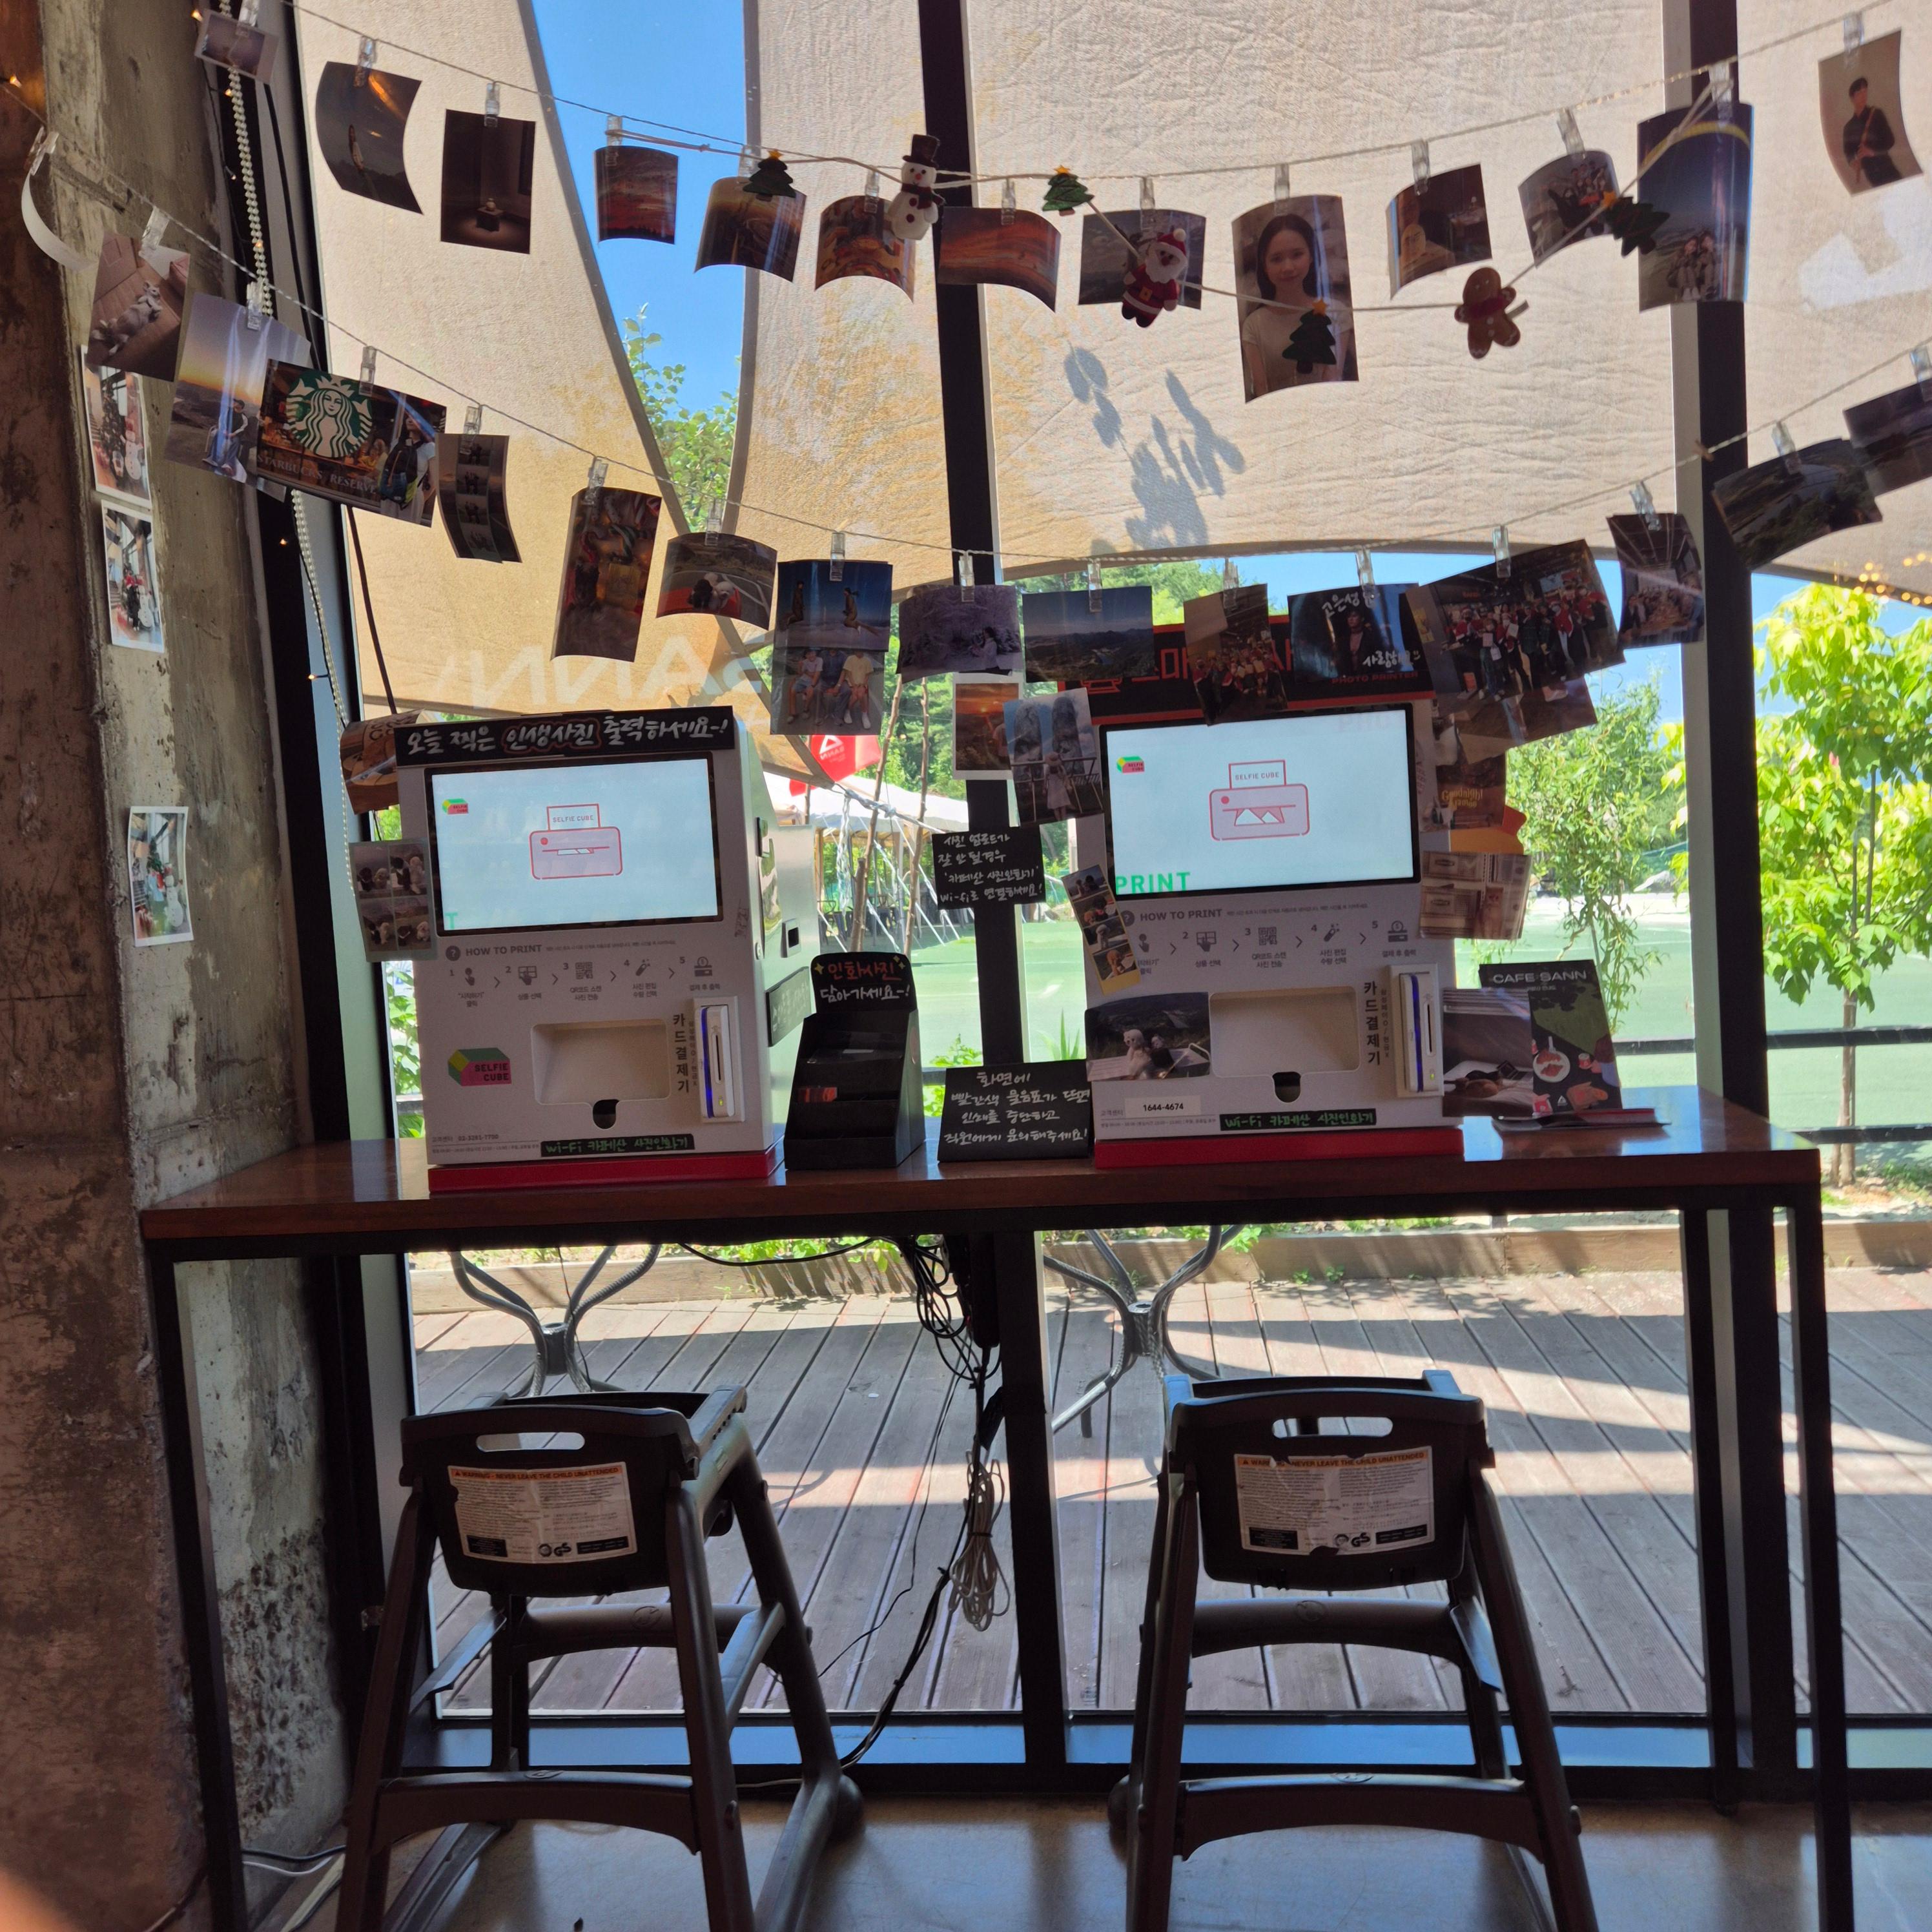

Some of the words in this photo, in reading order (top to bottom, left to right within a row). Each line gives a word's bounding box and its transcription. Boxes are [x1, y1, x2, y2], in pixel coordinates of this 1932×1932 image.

[407, 729, 444, 755] 오늘
[449, 726, 497, 752] 찍은
[506, 723, 594, 750] 인생사진
[1235, 772, 1259, 781] SELFIE
[943, 835, 966, 848] 사진
[938, 852, 952, 867] 잘
[956, 853, 966, 864] 안
[1116, 872, 1191, 894] PRINT
[984, 883, 1042, 901] 연결하세요!
[1140, 912, 1167, 921] HOW
[1169, 911, 1184, 920] TO
[1188, 909, 1222, 919] PRINT
[466, 947, 490, 956] HOW
[510, 945, 542, 954] PRINT
[828, 960, 902, 980] 인화사진
[1493, 972, 1536, 984] CAFE
[1539, 970, 1587, 981] SANN
[1364, 981, 1380, 1065] 카드결제기
[673, 1013, 689, 1093] 카드결제기
[475, 1064, 508, 1072] SELFIE
[483, 1073, 509, 1081] CUBE
[976, 1071, 1031, 1087] 화면에
[951, 1091, 1000, 1106] 빨간색
[1006, 1089, 1057, 1105] 물음표가
[1143, 1103, 1184, 1111] 1644-4674
[961, 1109, 1000, 1124] 인쇄를
[1006, 1110, 1060, 1124] 중단하고
[1269, 1115, 1310, 1126] 카페산
[1317, 1113, 1373, 1125] 사진인화기
[588, 1138, 627, 1153] 카페산
[634, 1136, 688, 1150] 사진인화기
[944, 1132, 1002, 1146] 직원에게
[1007, 1128, 1087, 1143] 문의해주세요!
[1379, 1453, 1424, 1463] UNATTENDED
[574, 1468, 619, 1477] UNATTENDED
